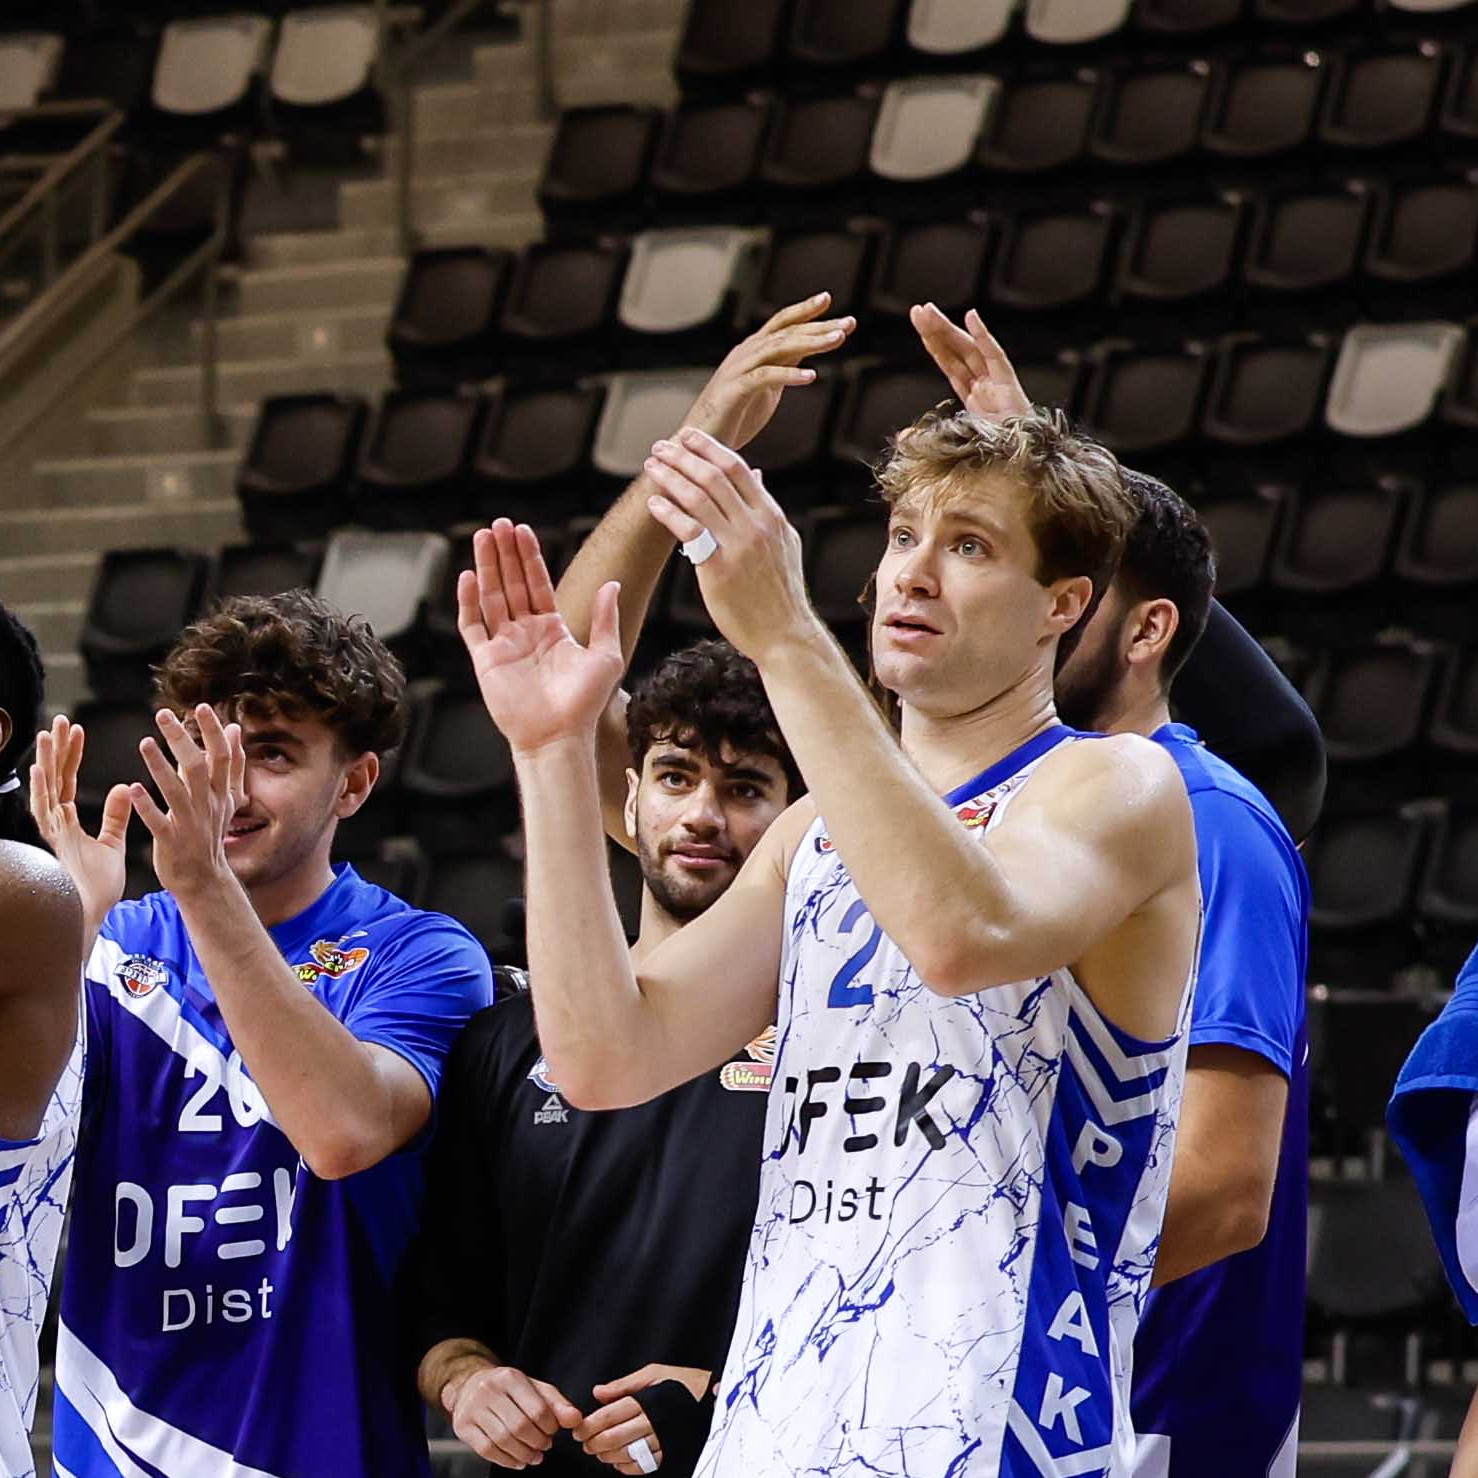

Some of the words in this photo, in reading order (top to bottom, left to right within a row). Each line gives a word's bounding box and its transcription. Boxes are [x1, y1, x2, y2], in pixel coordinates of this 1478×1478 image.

[827, 899, 884, 1009] 2
[734, 1070, 772, 1085] Winn
[534, 1110, 569, 1125] PEAK
[1040, 1120, 1123, 1445] PEAK
